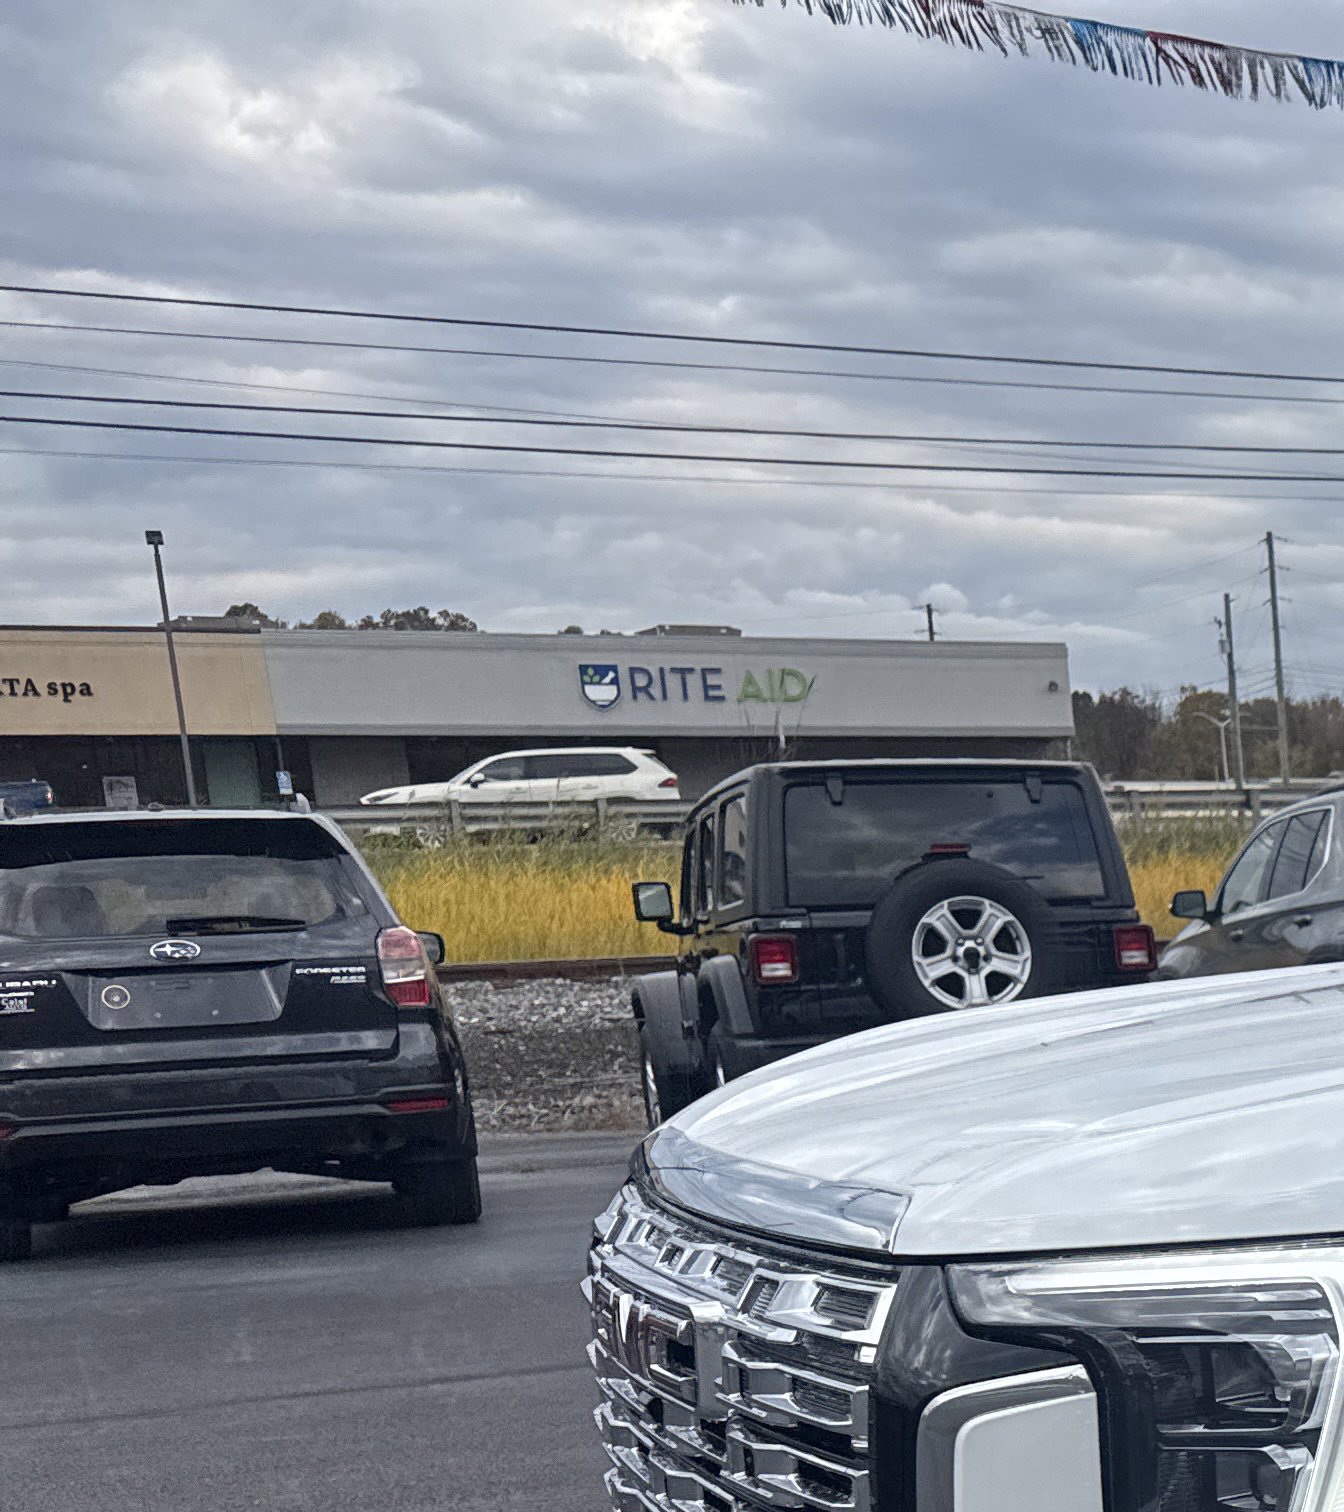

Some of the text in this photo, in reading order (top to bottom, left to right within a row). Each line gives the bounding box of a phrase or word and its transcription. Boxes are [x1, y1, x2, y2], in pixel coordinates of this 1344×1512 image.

[0, 677, 94, 703] TA spa
[629, 666, 809, 703] RITE AID
